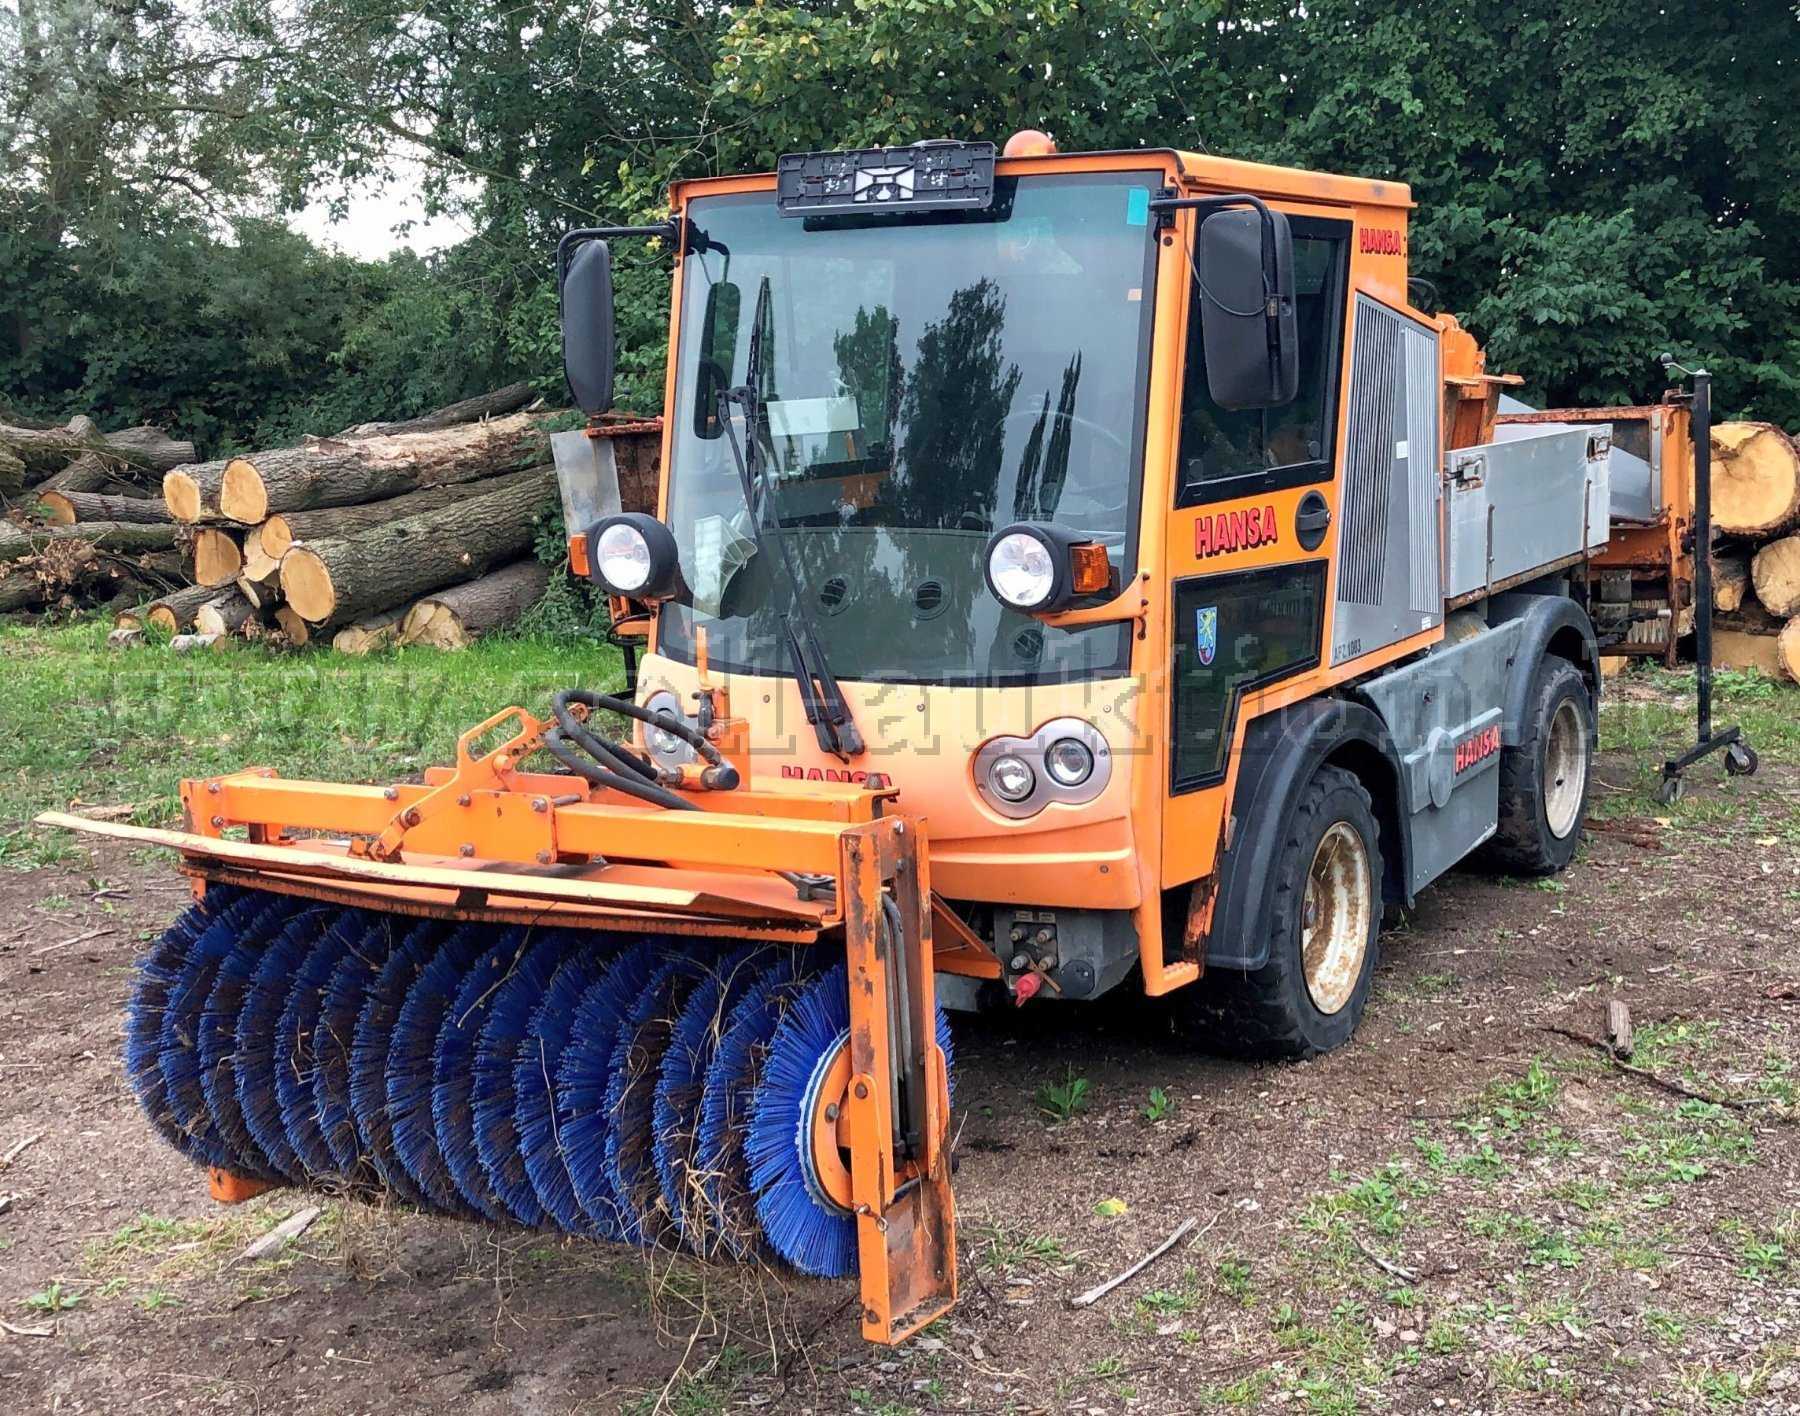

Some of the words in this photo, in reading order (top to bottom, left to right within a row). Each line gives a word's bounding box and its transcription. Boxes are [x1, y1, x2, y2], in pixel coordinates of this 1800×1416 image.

[1360, 228, 1401, 256] HANSA
[1195, 506, 1278, 560] HANSA
[1455, 725, 1500, 776] HANSA
